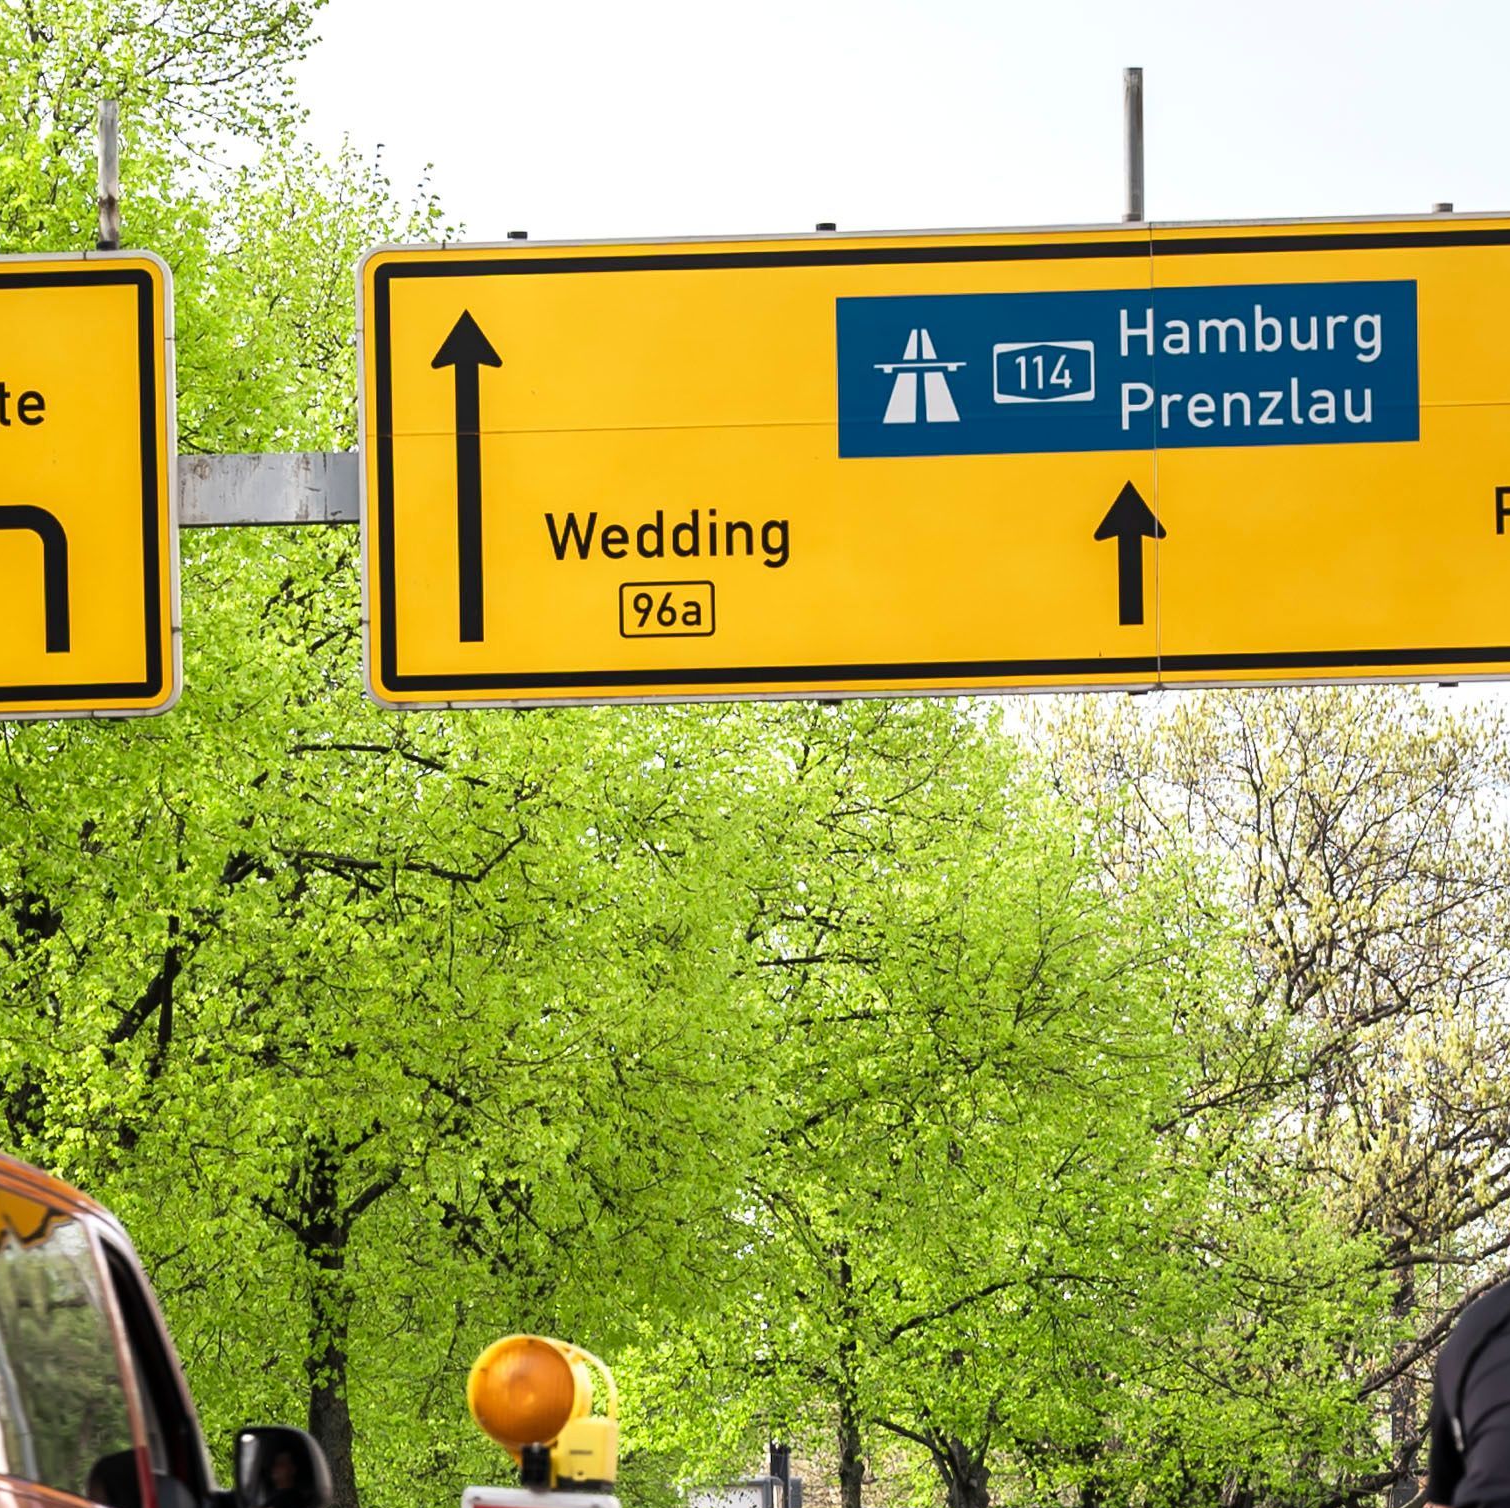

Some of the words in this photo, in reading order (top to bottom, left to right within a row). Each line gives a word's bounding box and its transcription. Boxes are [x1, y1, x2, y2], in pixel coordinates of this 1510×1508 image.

[1120, 305, 1382, 363] Hamburg
[1015, 354, 1073, 391] 114
[1121, 377, 1372, 431] Prenzlau
[544, 509, 790, 569] Wedding
[633, 592, 702, 628] 96a
